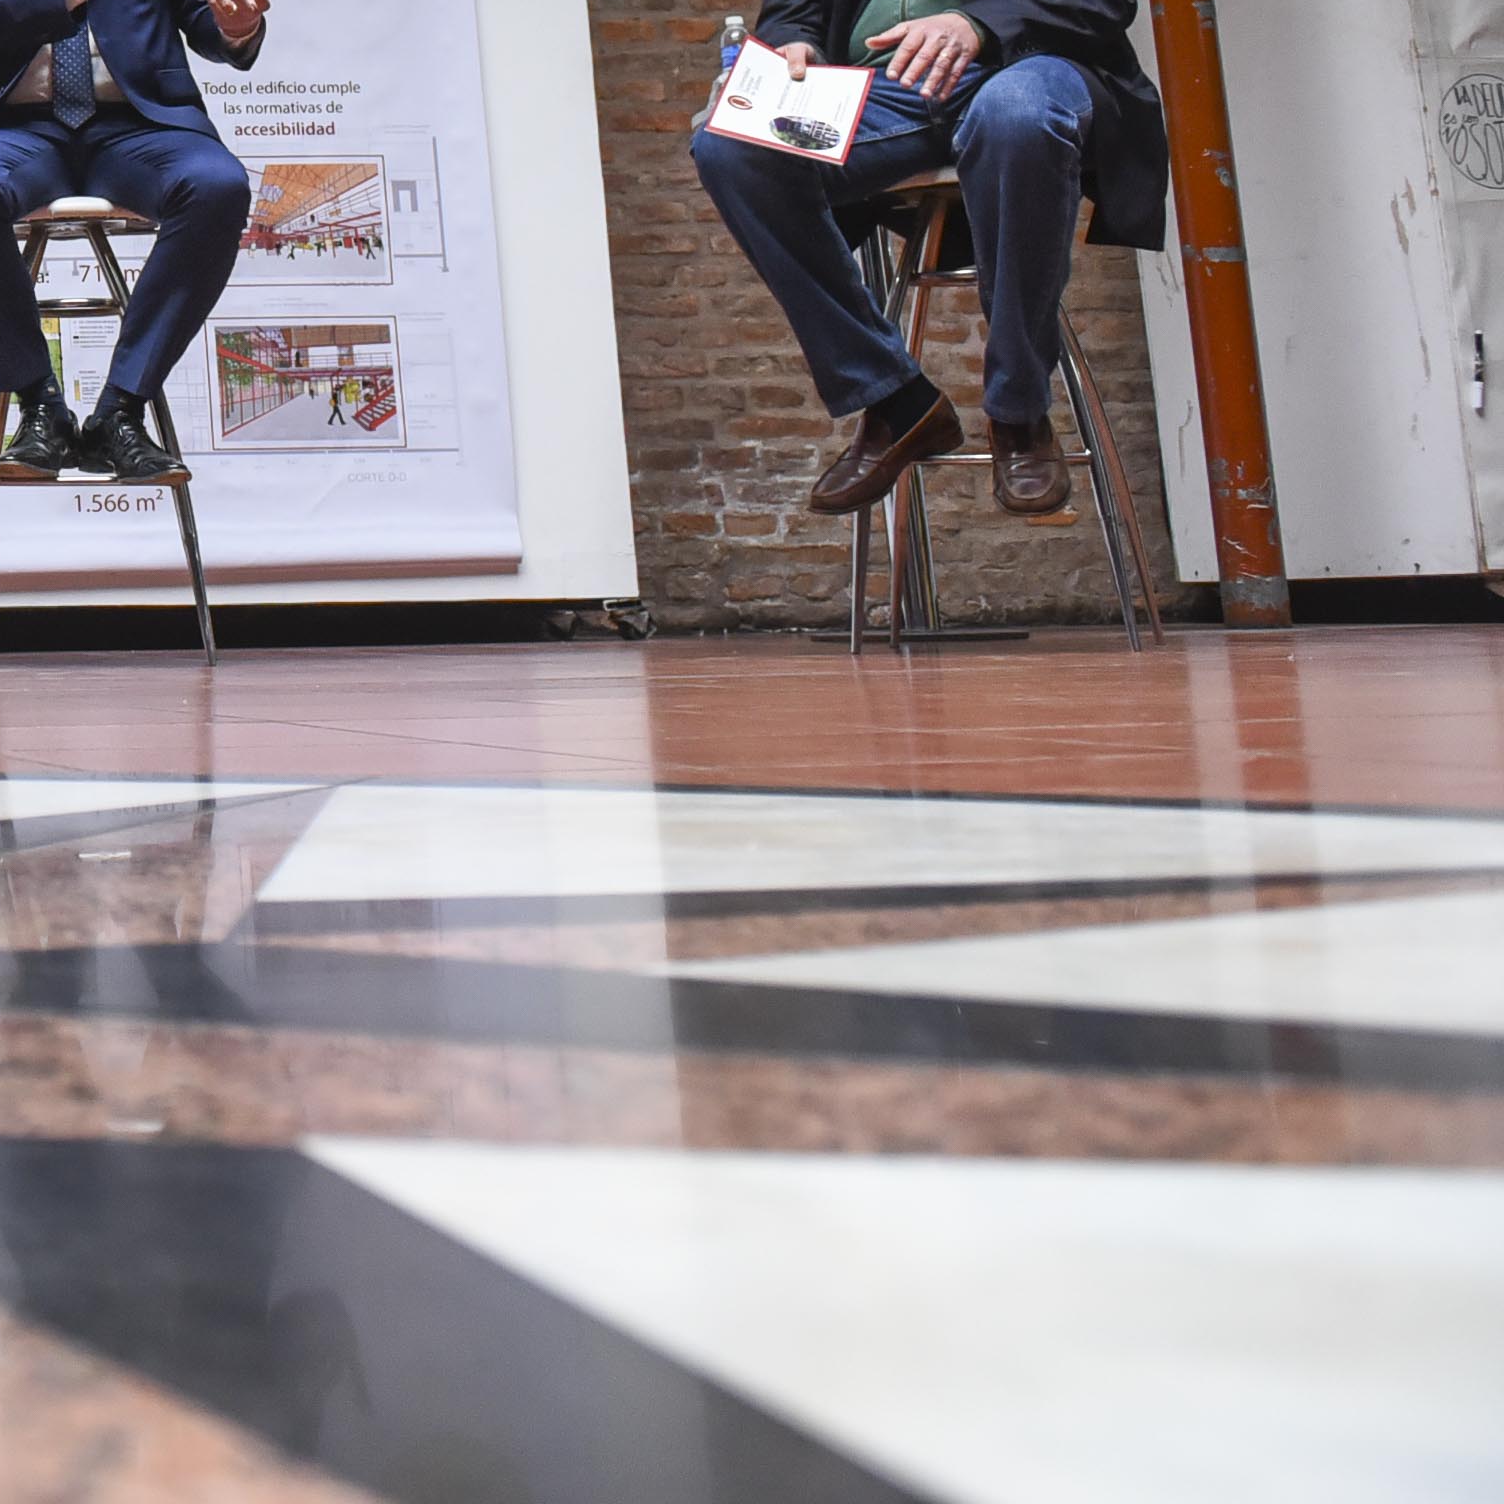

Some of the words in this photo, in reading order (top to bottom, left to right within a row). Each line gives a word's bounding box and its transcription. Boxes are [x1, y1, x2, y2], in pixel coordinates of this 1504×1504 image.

[202, 82, 236, 94] Todo
[241, 82, 252, 94] el
[256, 81, 306, 94] edificio
[310, 81, 360, 96] cumple
[224, 102, 242, 114] las
[246, 102, 322, 114] normativas
[326, 101, 343, 113] de
[235, 122, 335, 136] accesibilidad
[74, 495, 129, 512] 1.566
